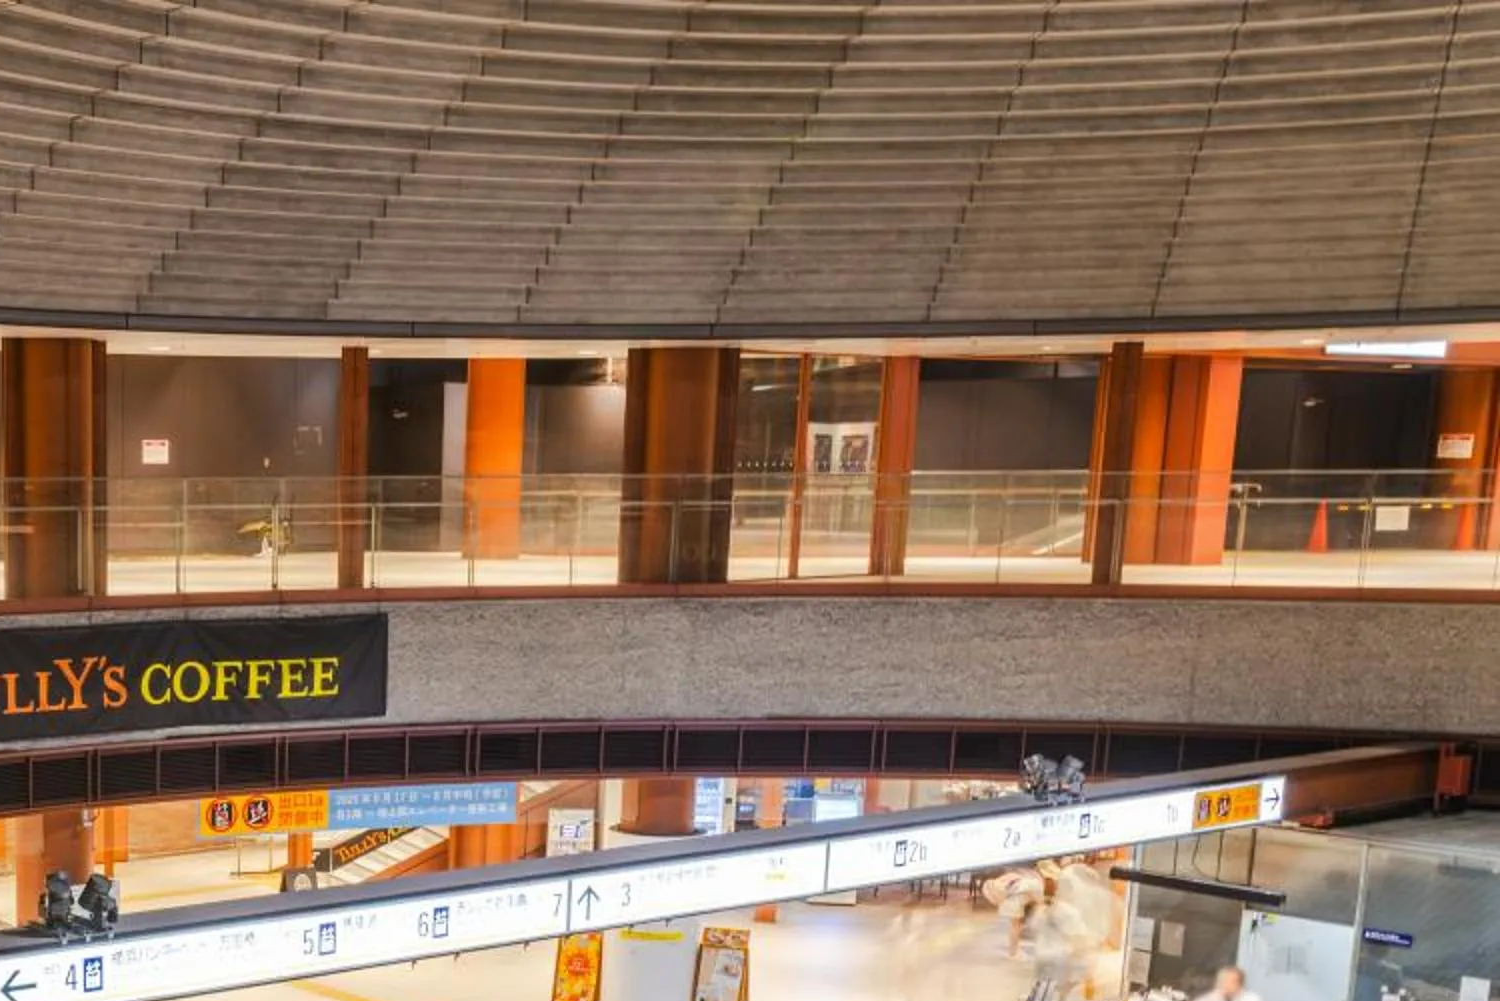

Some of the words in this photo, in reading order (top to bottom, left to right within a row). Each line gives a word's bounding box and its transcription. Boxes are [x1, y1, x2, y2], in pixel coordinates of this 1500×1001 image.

[140, 655, 340, 705] COFFEE
[620, 883, 632, 907] 3
[417, 913, 430, 938] 6
[302, 929, 315, 956] 5
[64, 963, 78, 992] 4
